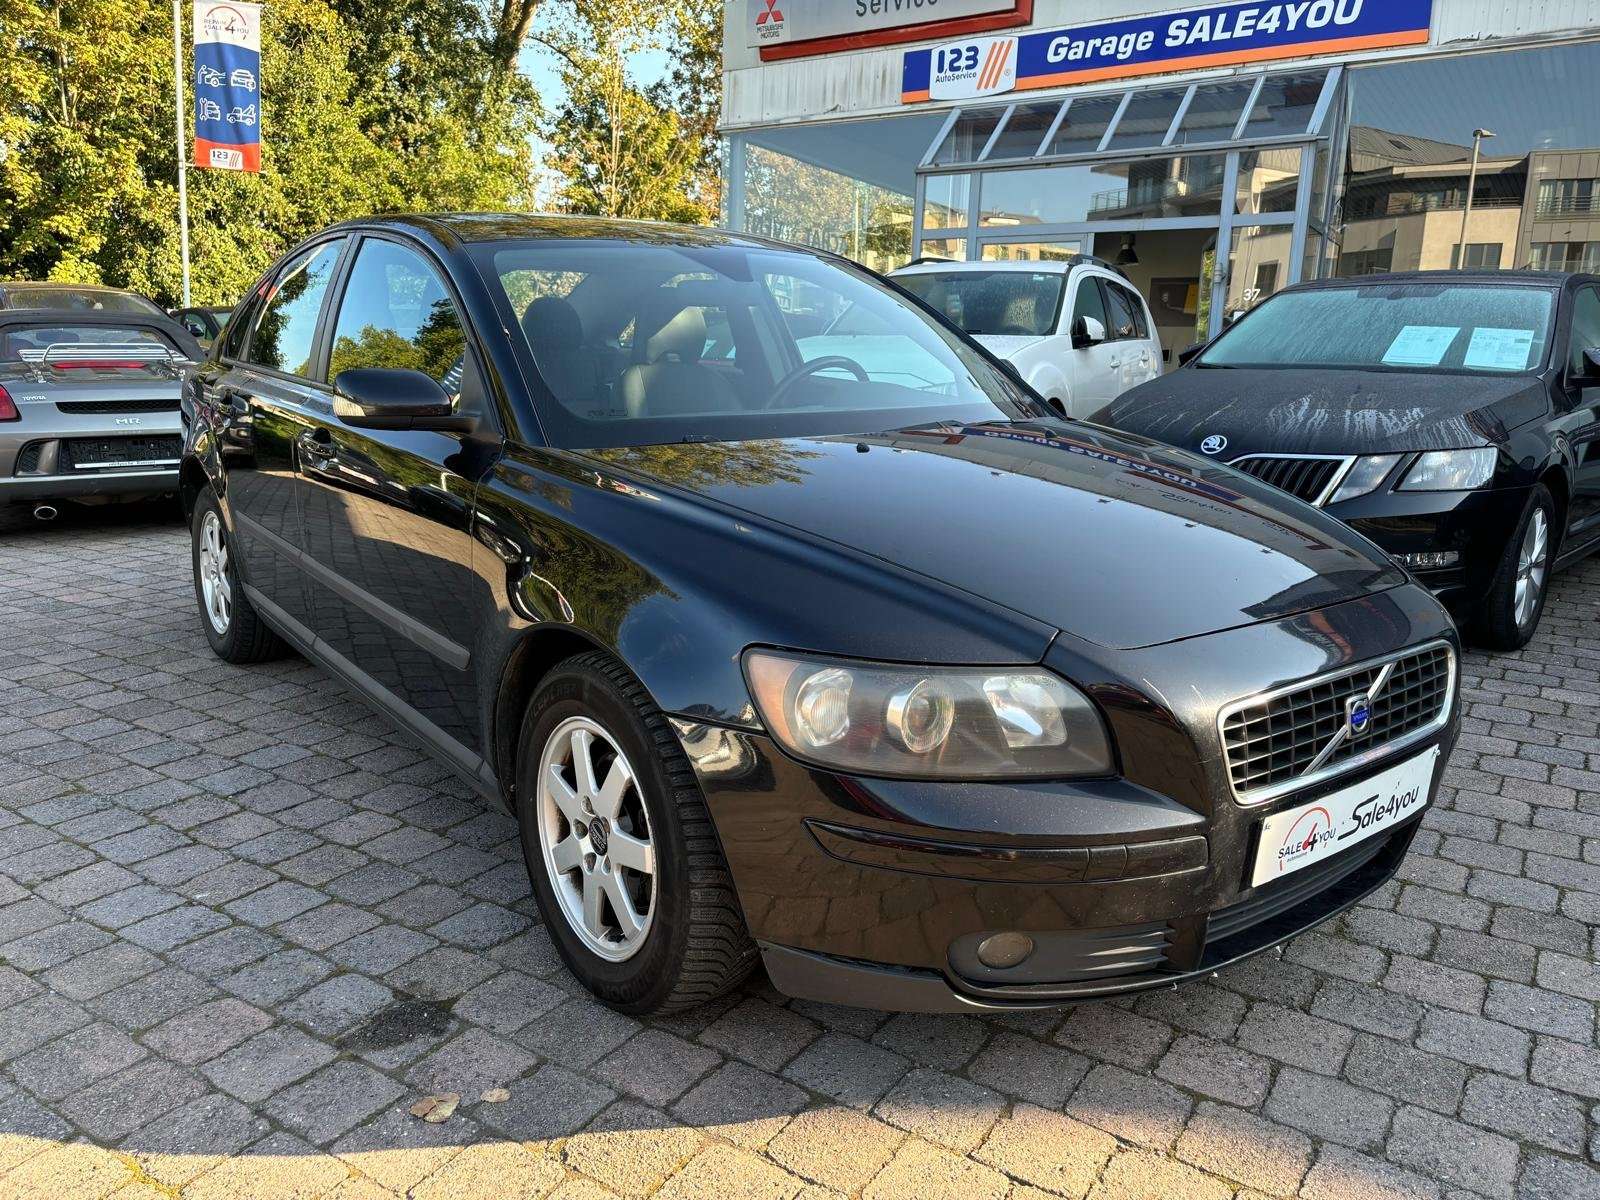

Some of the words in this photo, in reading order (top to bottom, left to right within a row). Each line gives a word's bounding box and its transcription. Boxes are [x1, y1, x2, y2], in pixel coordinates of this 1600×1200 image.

[1046, 31, 1154, 64] Garage
[1164, 0, 1364, 47] SALE4YOU
[935, 71, 977, 83] AutoService
[1243, 288, 1261, 302] 37
[1337, 785, 1420, 841] Sale4you
